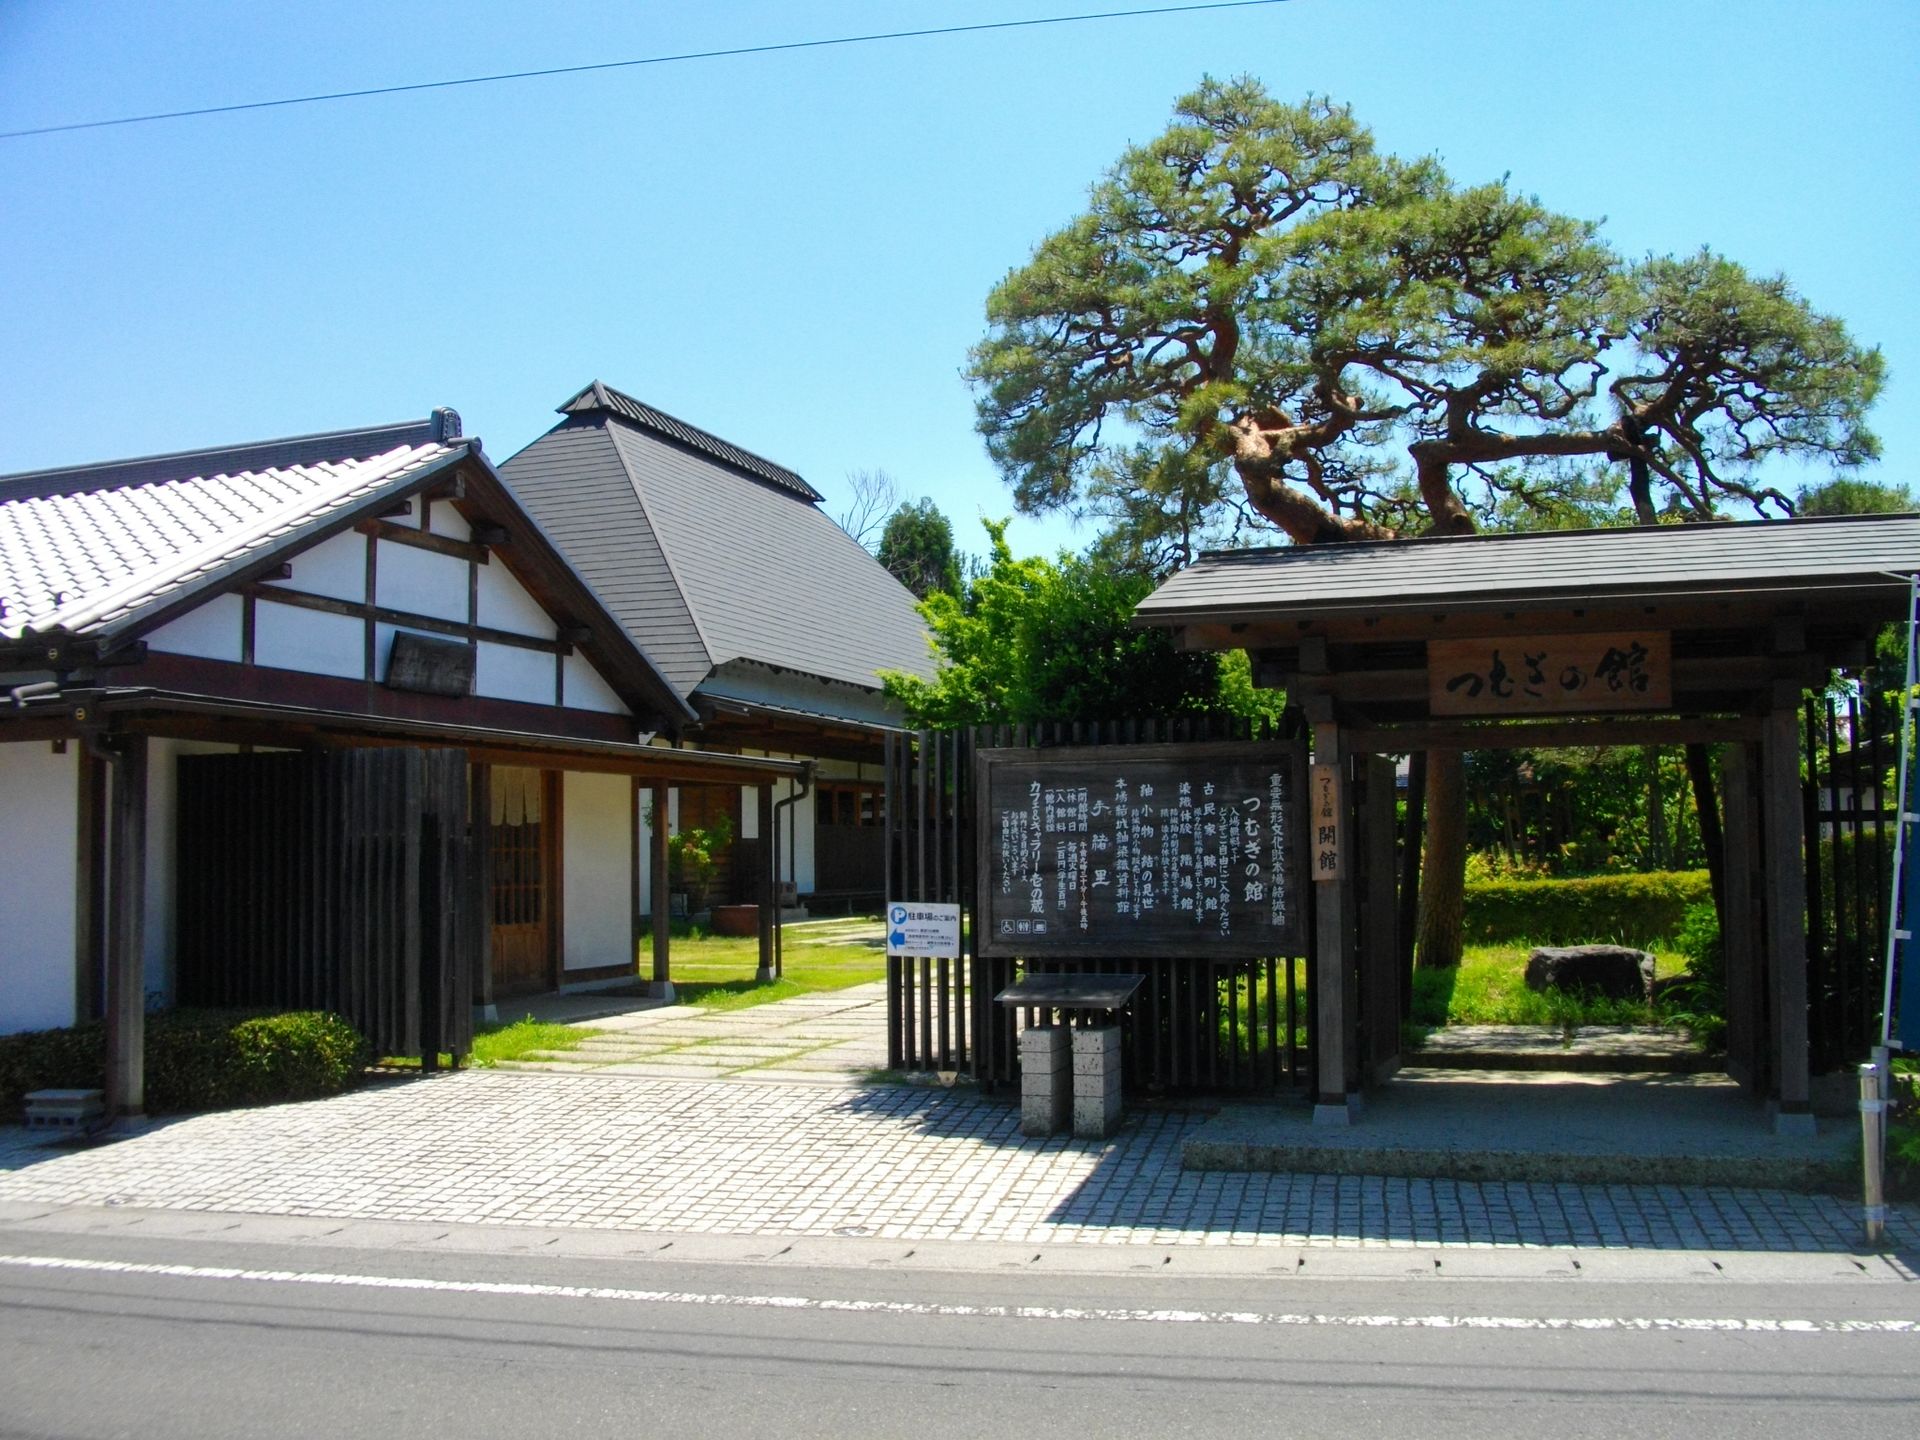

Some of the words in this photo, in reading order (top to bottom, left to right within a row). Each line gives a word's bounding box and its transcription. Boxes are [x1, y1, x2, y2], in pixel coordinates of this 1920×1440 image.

[1090, 799, 1111, 888] 手緒里
[1140, 784, 1154, 838] 紬小物
[1203, 782, 1217, 836] 古民家
[1218, 807, 1230, 937] どうぞご自由にご入館ください
[1243, 796, 1263, 902] つむぎの館
[1318, 825, 1338, 871] 開館
